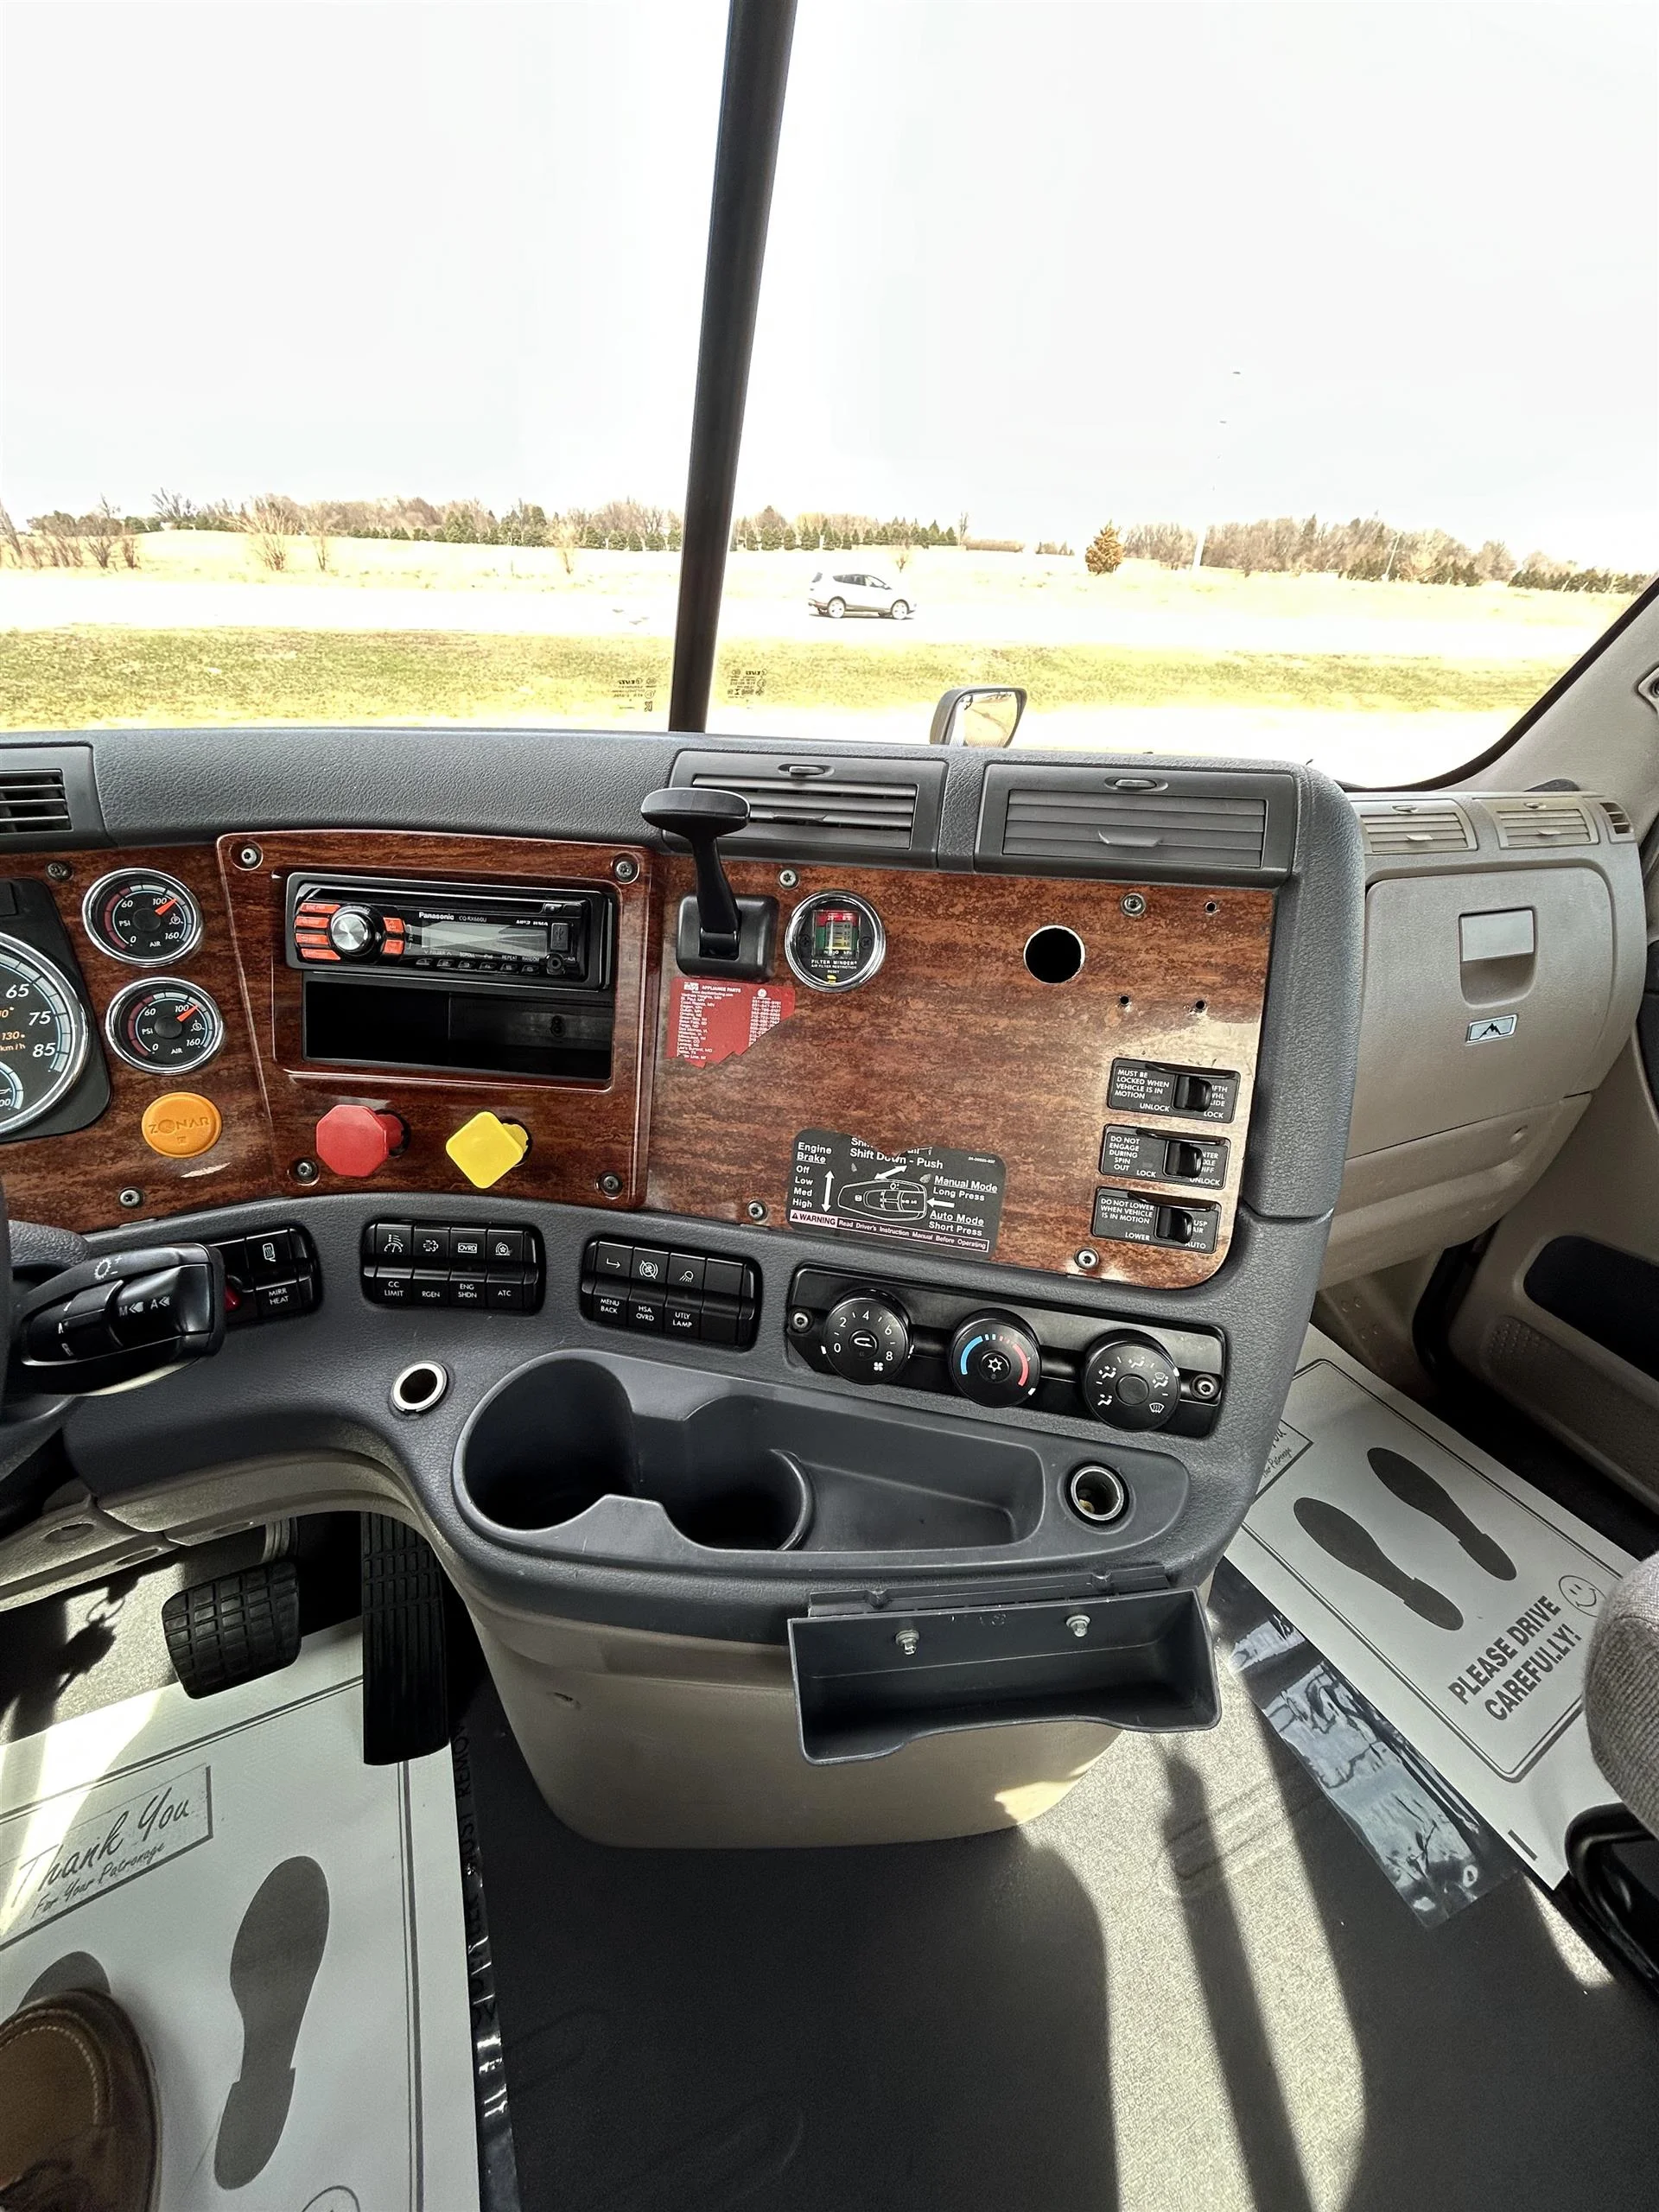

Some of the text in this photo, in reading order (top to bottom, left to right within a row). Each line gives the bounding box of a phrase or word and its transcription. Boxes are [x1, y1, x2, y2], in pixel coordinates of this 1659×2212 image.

[121, 899, 134, 908] 60
[152, 897, 168, 906] 100
[418, 912, 454, 921] Panasonic
[165, 931, 180, 940] 160
[5, 983, 29, 999] 65
[144, 1007, 156, 1016] 60
[175, 1005, 189, 1014] 100
[29, 1010, 52, 1027] 75
[152, 1043, 159, 1052] 0
[186, 1039, 200, 1047] 160
[32, 1042, 56, 1058] 85
[170, 1046, 183, 1055] AIR
[1117, 1069, 1138, 1077] MUST
[1116, 1076, 1170, 1088] LOCKED WHEN
[1116, 1083, 1145, 1092] VEHICLE
[1211, 1084, 1228, 1093] IFTH
[1115, 1090, 1146, 1099] MOTION
[1139, 1103, 1171, 1113] UNLOCK
[1203, 1110, 1224, 1119] LOCK
[148, 1116, 209, 1134] ZONAR
[1123, 1136, 1141, 1145] NOT
[798, 1141, 832, 1154] Engine
[1109, 1142, 1140, 1152] ENGAGE
[797, 1152, 826, 1164] Brake
[849, 1148, 874, 1160] Shift
[876, 1152, 907, 1164] Down
[917, 1157, 944, 1169] Push
[1109, 1149, 1138, 1159] DURING
[1114, 1156, 1131, 1165] SPIN
[796, 1165, 810, 1174] Off
[1113, 1163, 1130, 1172] OUT
[1136, 1169, 1157, 1179] LOCK
[795, 1176, 813, 1185] Low
[934, 1175, 998, 1192] Manual Mode
[1189, 1177, 1221, 1186] UNLOCK
[793, 1187, 812, 1197] Med
[933, 1186, 985, 1202] Long Press
[792, 1198, 812, 1209] High
[1113, 1199, 1129, 1208] NOT
[1129, 1202, 1155, 1211] LOWER
[1100, 1205, 1154, 1218] WHEN VEHICLE
[799, 1213, 836, 1225] WARNING
[930, 1210, 984, 1225] Auto Mode
[1119, 1214, 1151, 1224] MOTION
[928, 1221, 982, 1236] Short Press
[838, 1219, 986, 1249] Read Driver's Instruction Manual Before Operating
[1124, 1231, 1151, 1242] LOWER
[459, 1244, 477, 1253] OVRD
[1185, 1241, 1207, 1249] AUTO
[268, 1287, 288, 1297] MIRR
[149, 1299, 159, 1310] A
[270, 1295, 289, 1305] HEAT
[601, 1298, 620, 1306] MENU
[118, 1306, 129, 1317] M
[601, 1306, 618, 1314] BACK
[638, 1305, 652, 1313] HSA
[636, 1313, 655, 1322] OVRD
[675, 1311, 691, 1319] UTLY
[862, 1310, 869, 1321] 4
[672, 1319, 692, 1328] LAMP
[839, 1317, 847, 1328] 2
[884, 1325, 892, 1336] 6
[833, 1343, 842, 1353] 0
[886, 1351, 893, 1361] 8
[1447, 1595, 1562, 1705] PLEASE DRIVE
[1484, 1624, 1582, 1721] CAREFULLY!
[10, 1787, 189, 1908] Thank You
[30, 1894, 59, 1920] For
[96, 1842, 165, 1885] Patronage
